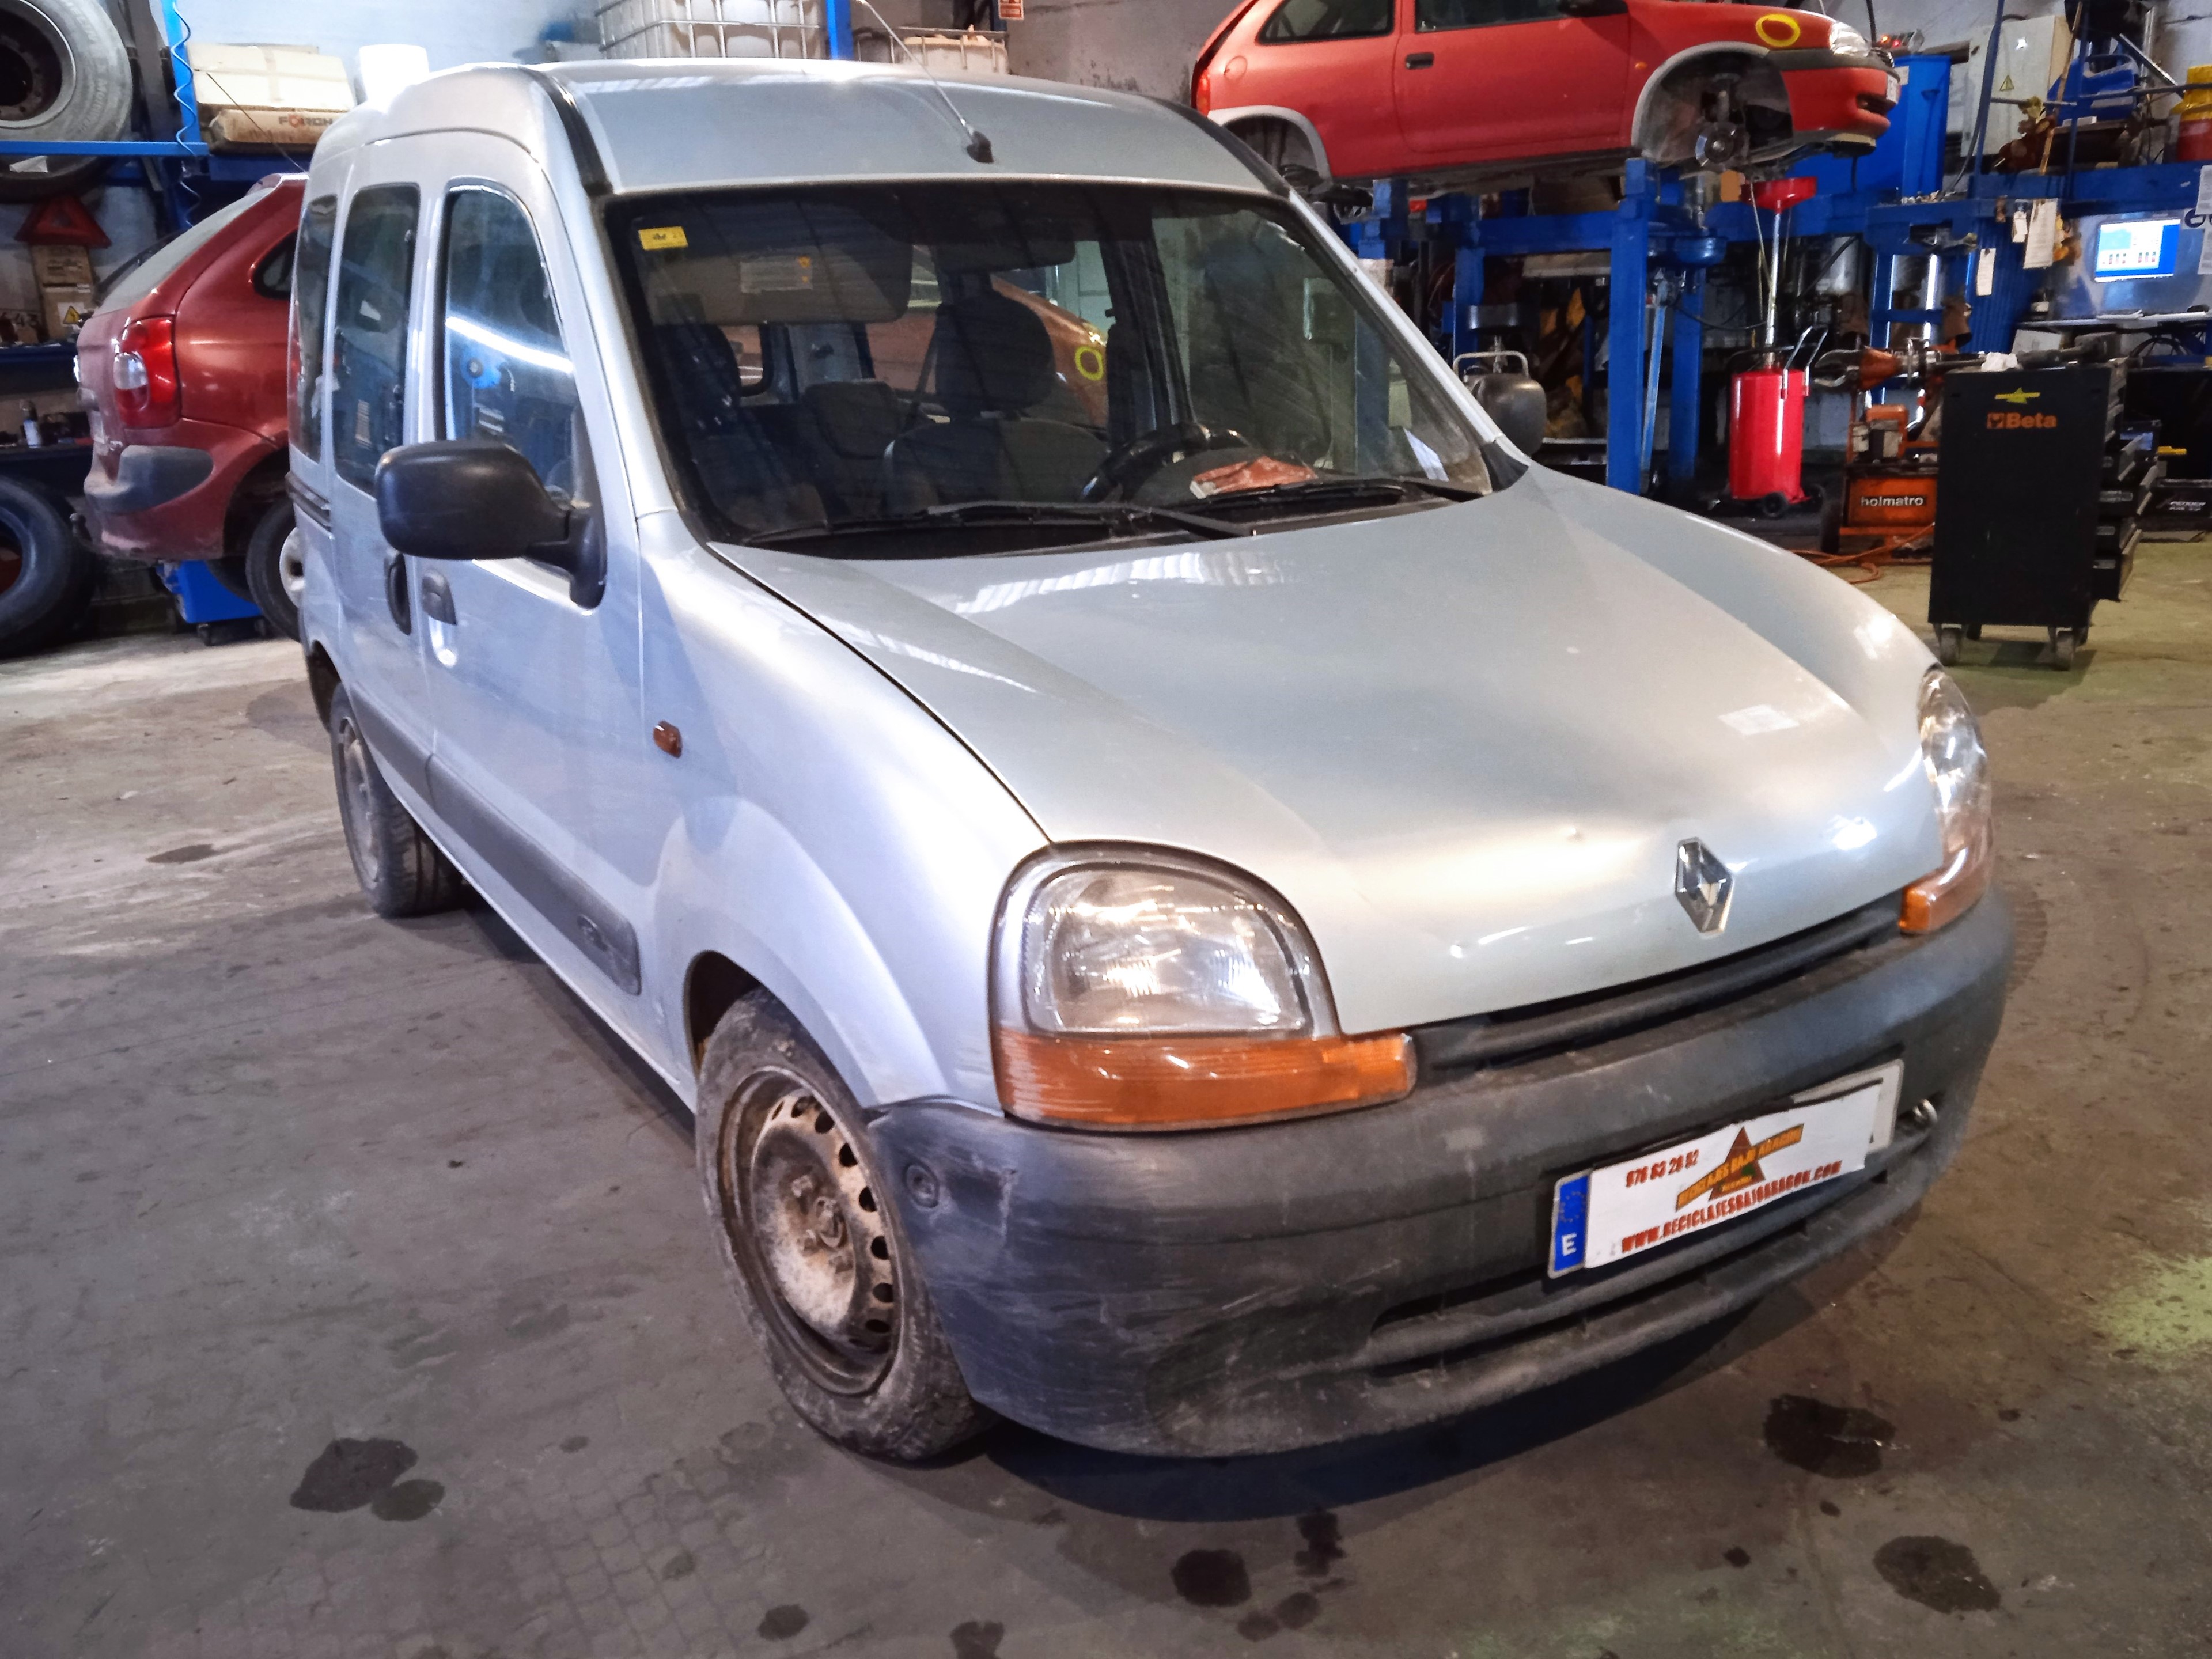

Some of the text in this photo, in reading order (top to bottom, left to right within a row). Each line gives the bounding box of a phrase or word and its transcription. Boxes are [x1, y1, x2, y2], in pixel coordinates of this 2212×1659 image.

[2006, 412, 2057, 429] Beta
[1861, 496, 1923, 506] holmatro
[1562, 1233, 1577, 1256] E
